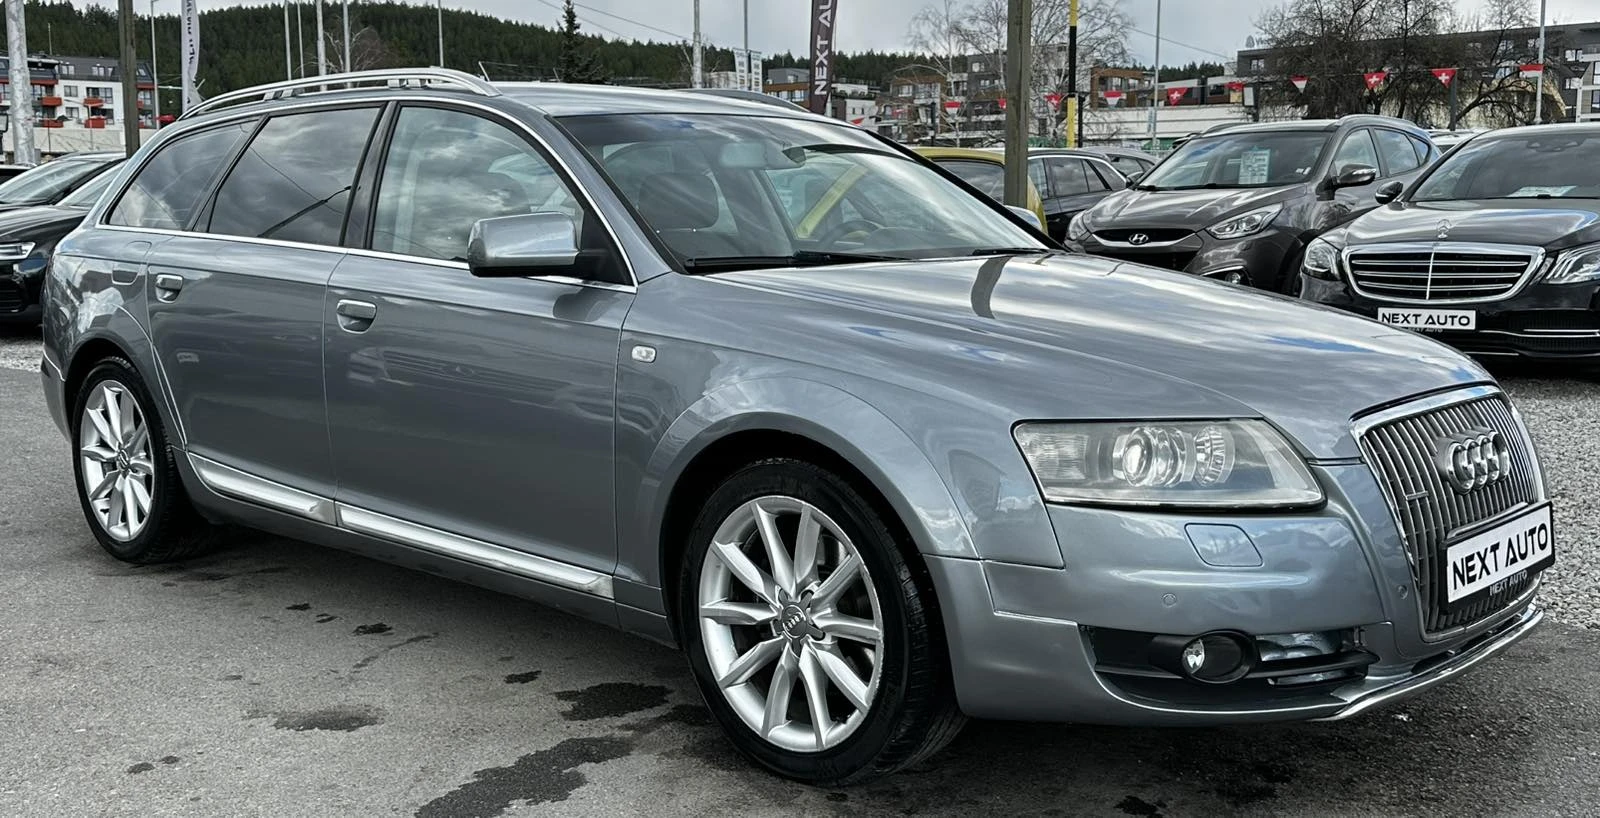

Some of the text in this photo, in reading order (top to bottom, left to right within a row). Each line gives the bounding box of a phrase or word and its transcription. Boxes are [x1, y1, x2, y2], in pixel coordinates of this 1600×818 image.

[814, 35, 829, 96] NEXT
[1381, 312, 1470, 326] NEXT AUTO
[1452, 523, 1548, 590] NEXT AUTO
[1489, 569, 1528, 596] NEXT AUTO
